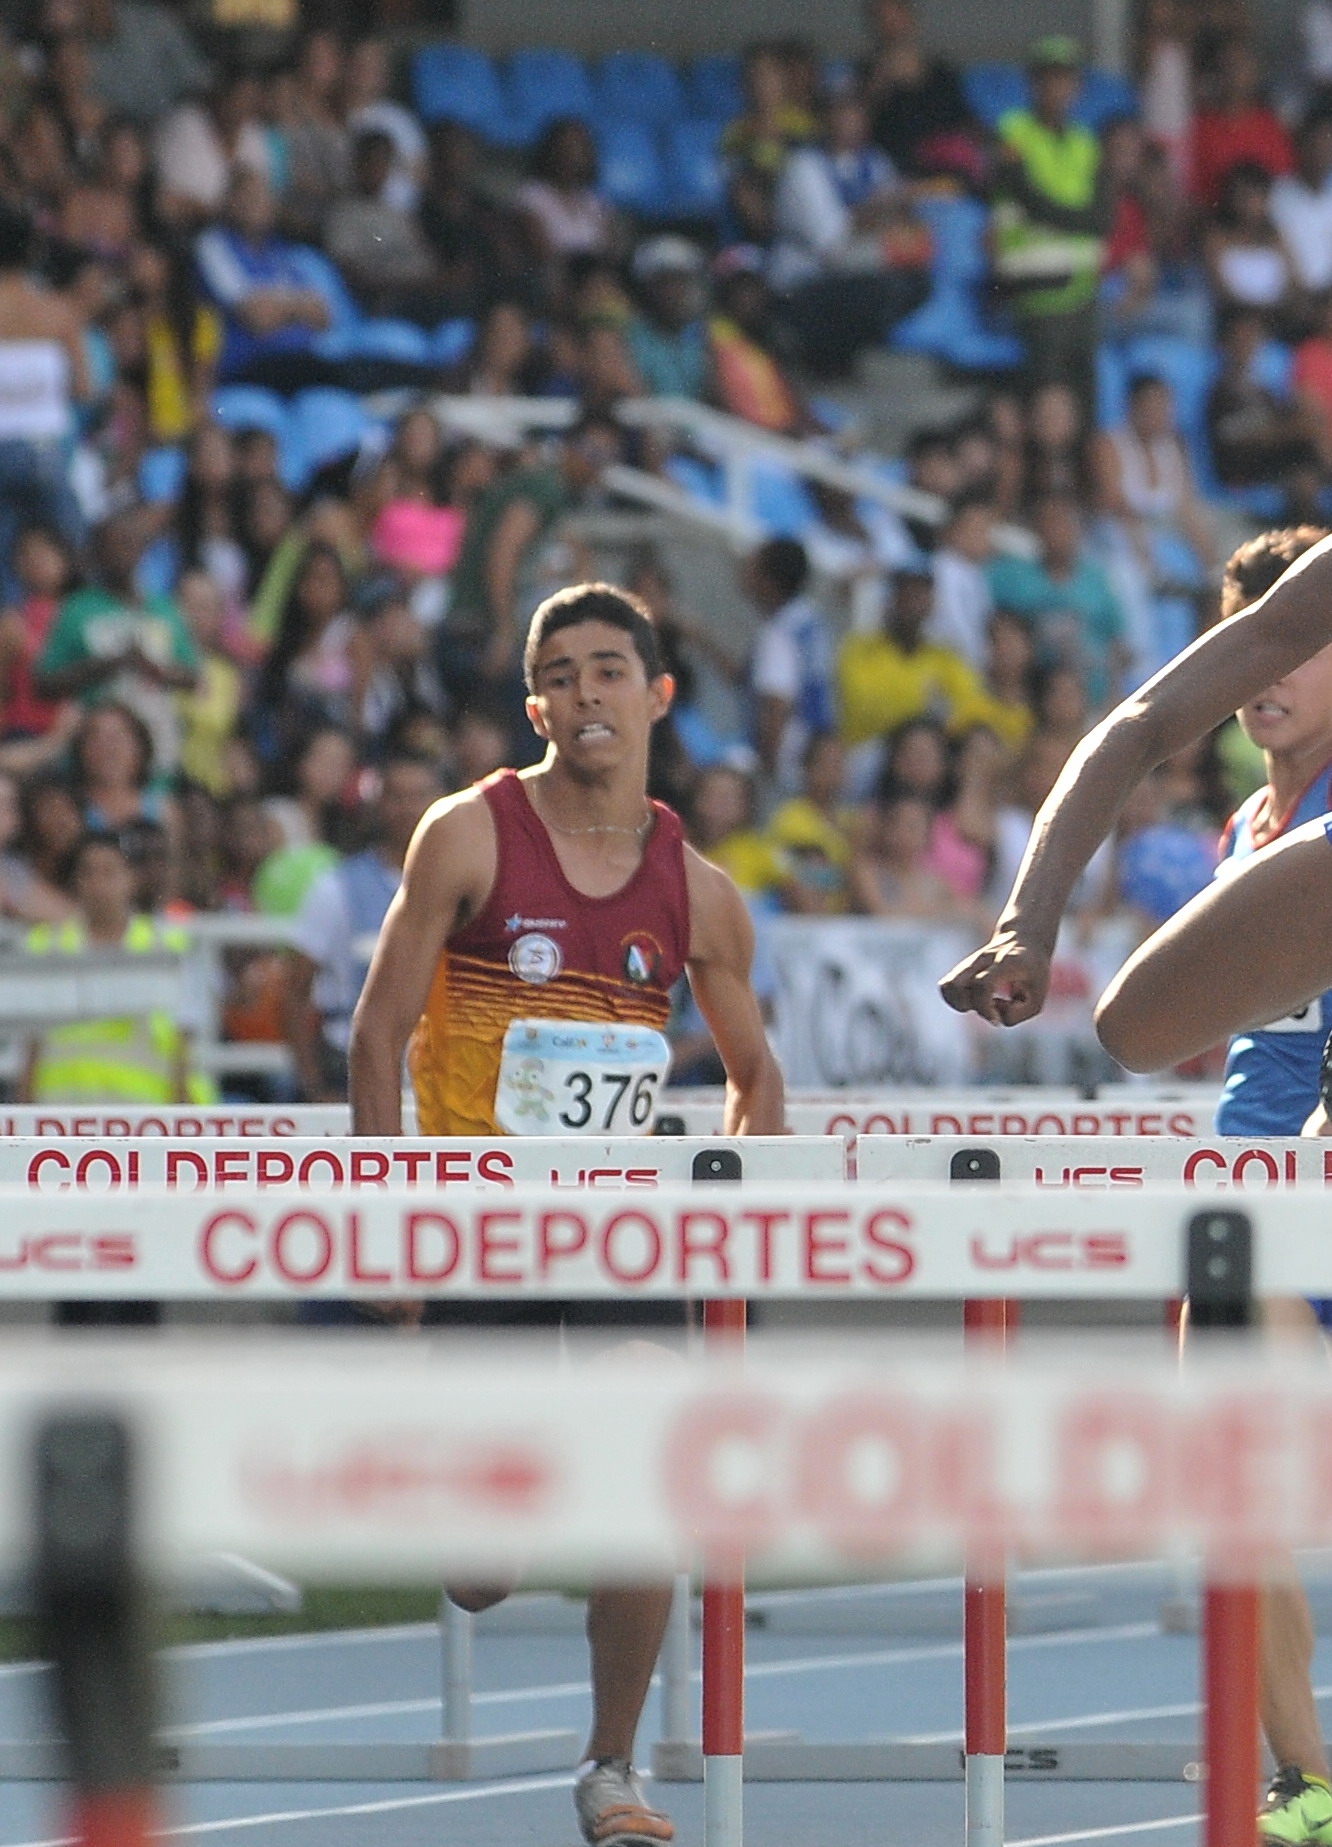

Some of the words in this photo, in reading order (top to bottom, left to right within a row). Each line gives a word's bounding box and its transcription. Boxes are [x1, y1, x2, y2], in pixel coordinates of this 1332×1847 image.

[559, 1072, 658, 1130] 376
[0, 1117, 297, 1137] LDEPORTES
[27, 1149, 515, 1195] COLDEPORTES
[200, 1208, 917, 1287] COLDEPORTES
[959, 1748, 1058, 1770] CS
